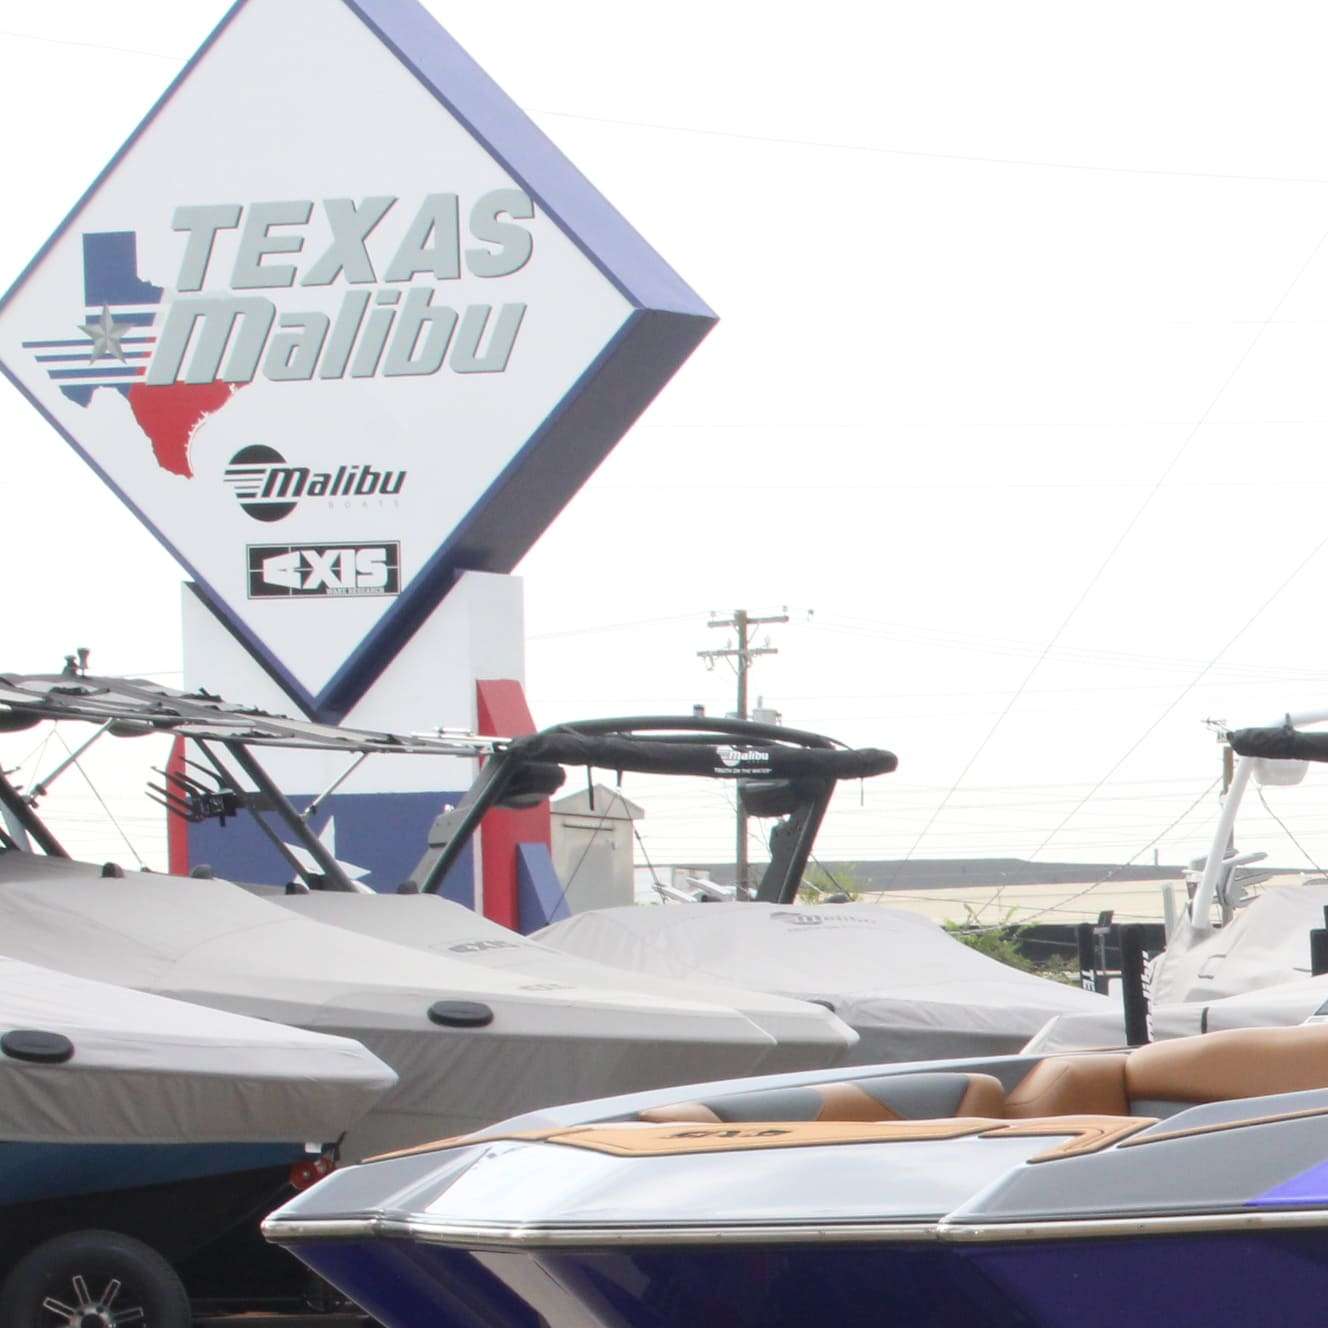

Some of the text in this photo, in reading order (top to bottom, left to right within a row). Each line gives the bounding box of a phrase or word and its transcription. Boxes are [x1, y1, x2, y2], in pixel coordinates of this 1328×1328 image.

[172, 188, 535, 292] TEXAS
[145, 287, 528, 386] Malibu
[261, 465, 407, 497] Malibu
[262, 548, 389, 590] AXIS
